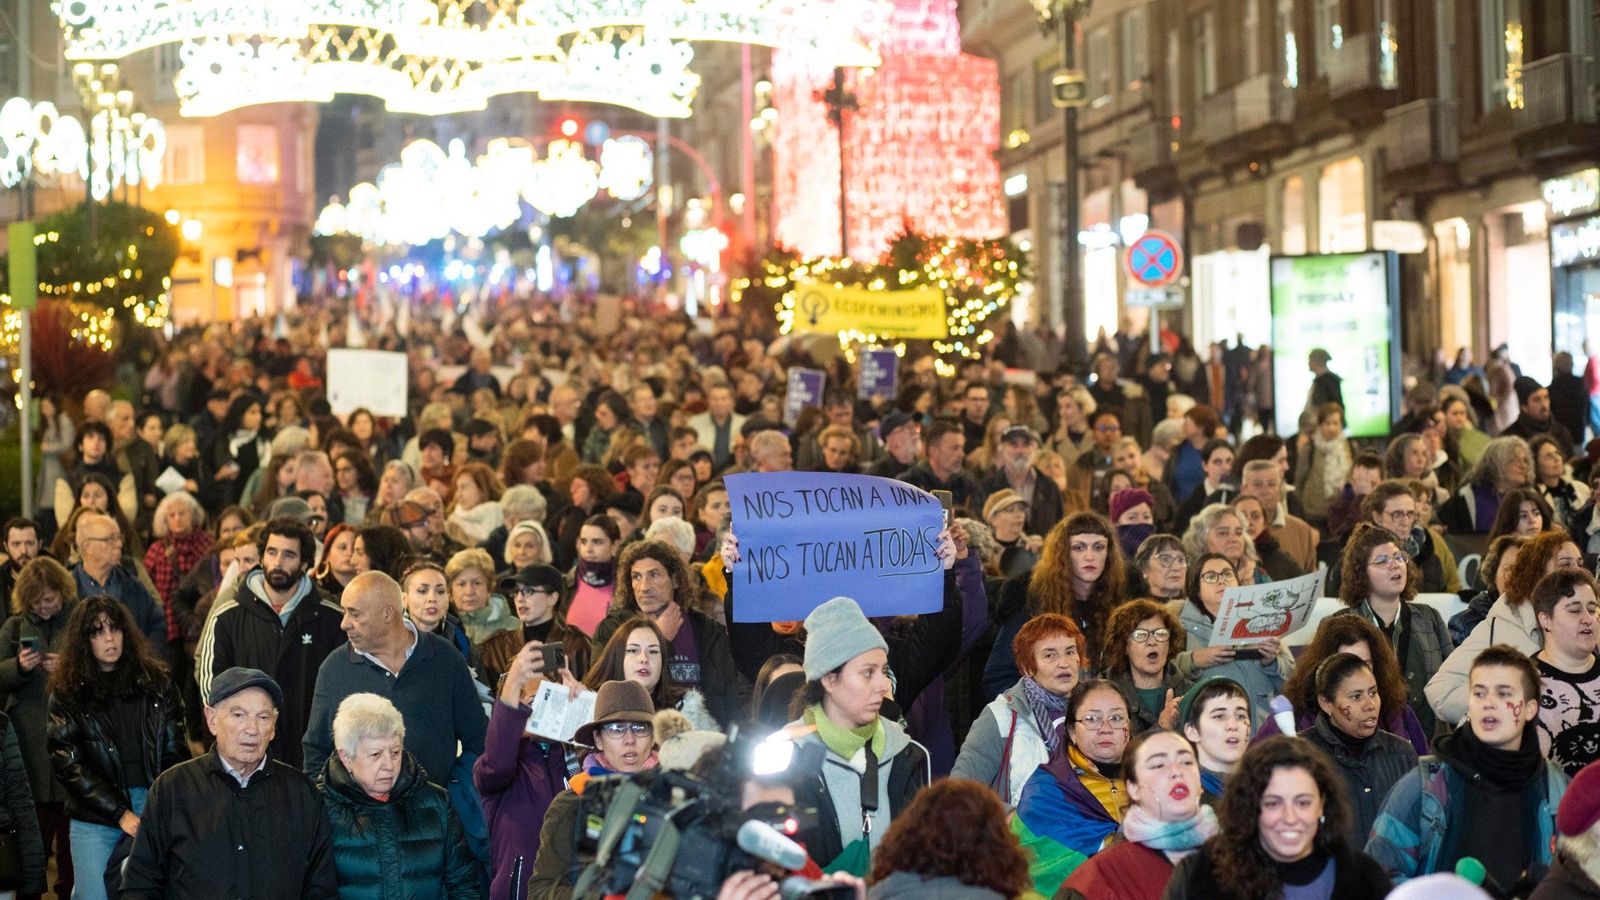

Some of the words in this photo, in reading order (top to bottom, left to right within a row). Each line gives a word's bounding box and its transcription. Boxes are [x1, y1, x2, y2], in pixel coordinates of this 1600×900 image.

[834, 299, 938, 317] ECOFEMINISMO
[743, 490, 794, 520] NOS
[793, 485, 864, 516] TOCAN
[869, 485, 883, 508] A
[889, 485, 930, 507] UNA
[747, 544, 790, 585] NOS
[796, 541, 857, 576] TOCAN
[861, 537, 875, 571] A
[863, 525, 942, 578] TODAS
